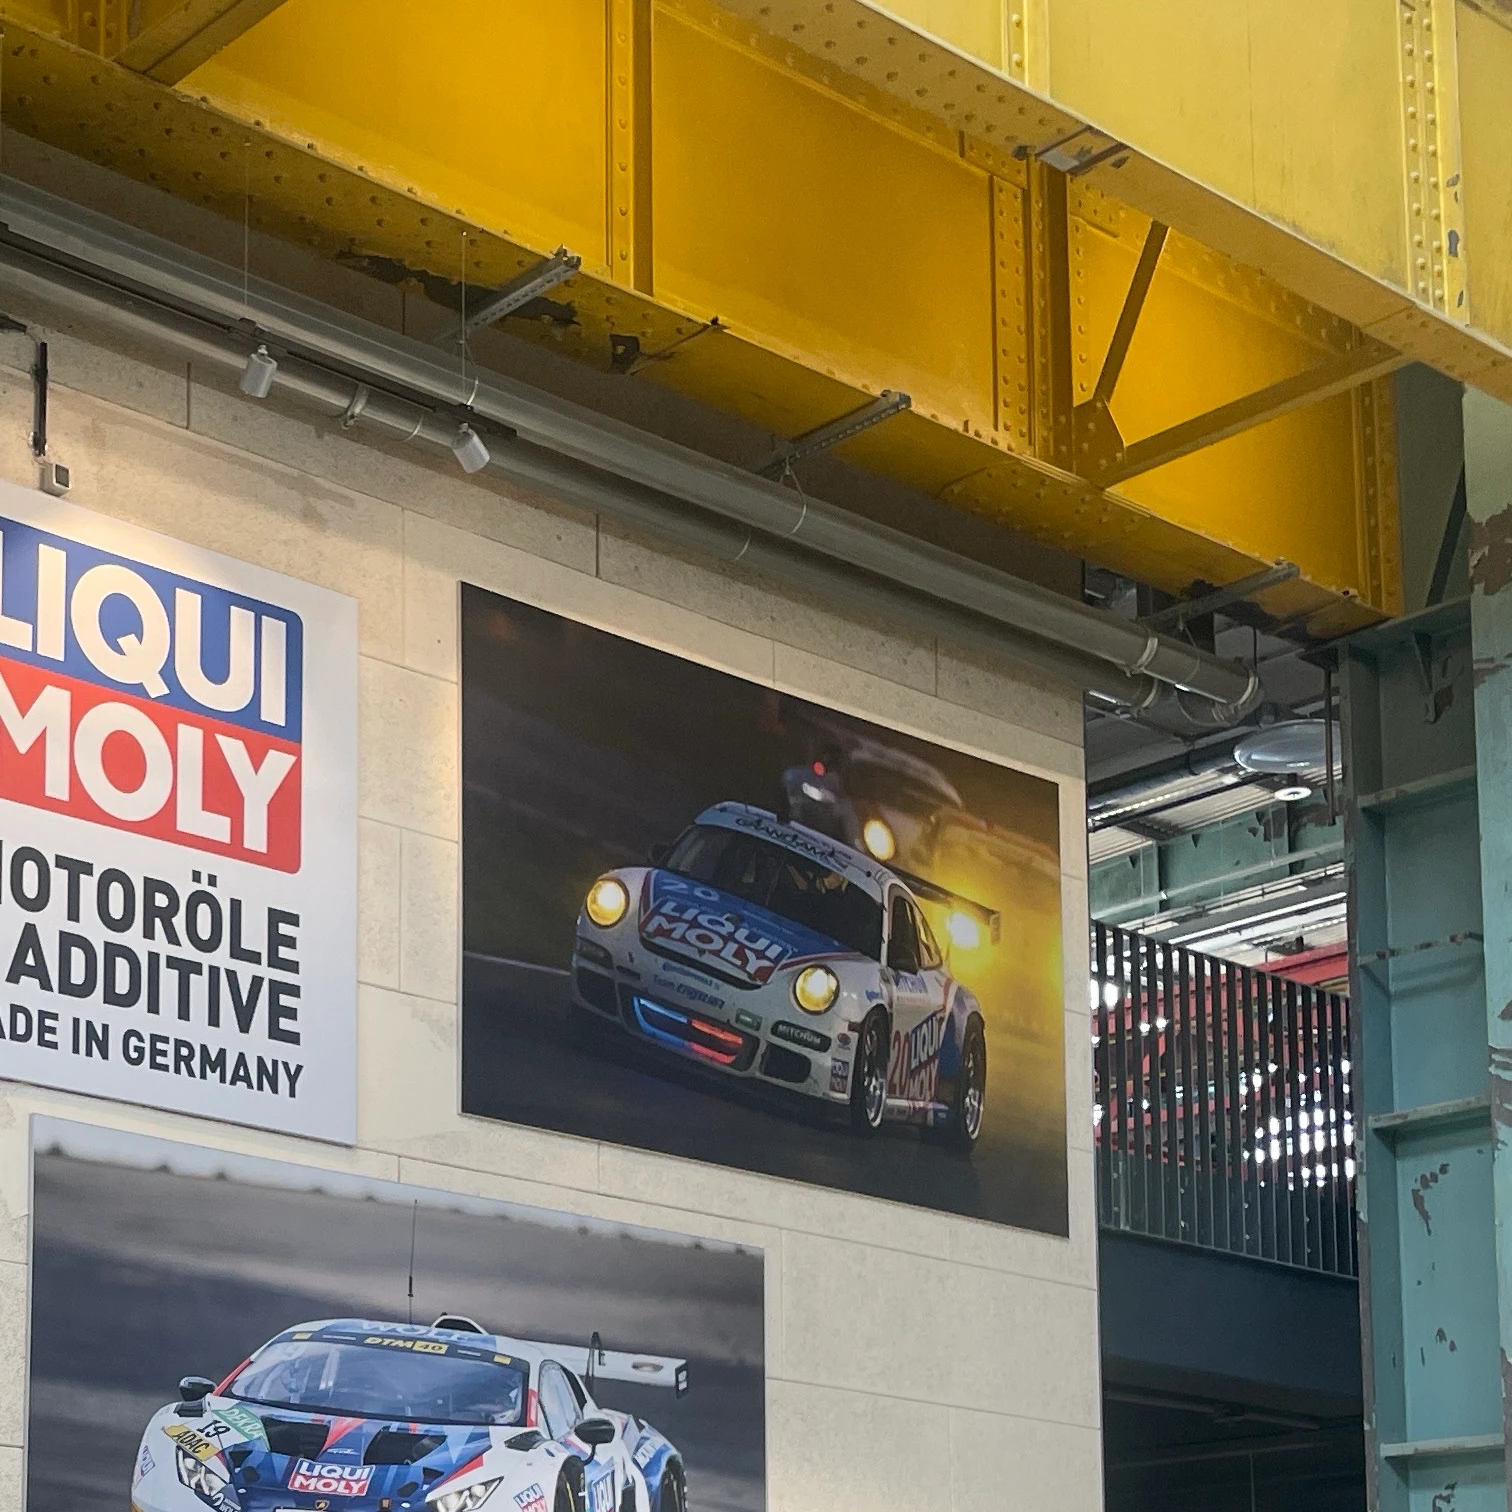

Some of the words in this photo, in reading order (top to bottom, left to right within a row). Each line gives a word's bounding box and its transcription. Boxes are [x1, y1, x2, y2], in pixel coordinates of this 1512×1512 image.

[659, 901, 784, 960] LIQUI
[644, 915, 775, 978] MOLY
[6, 923, 302, 1045] ADDITIVE
[72, 1018, 110, 1061] IN
[122, 1030, 304, 1098] GERMANY
[887, 1030, 910, 1096] 20
[364, 1337, 415, 1348] DTM
[418, 1342, 443, 1352] 40
[196, 1419, 231, 1438] 19
[220, 1406, 265, 1438] DEKRA
[171, 1431, 210, 1455] ADAC
[299, 1461, 371, 1480] LIQUI
[293, 1476, 368, 1494] MOLY
[516, 1484, 544, 1508] LIQUI
